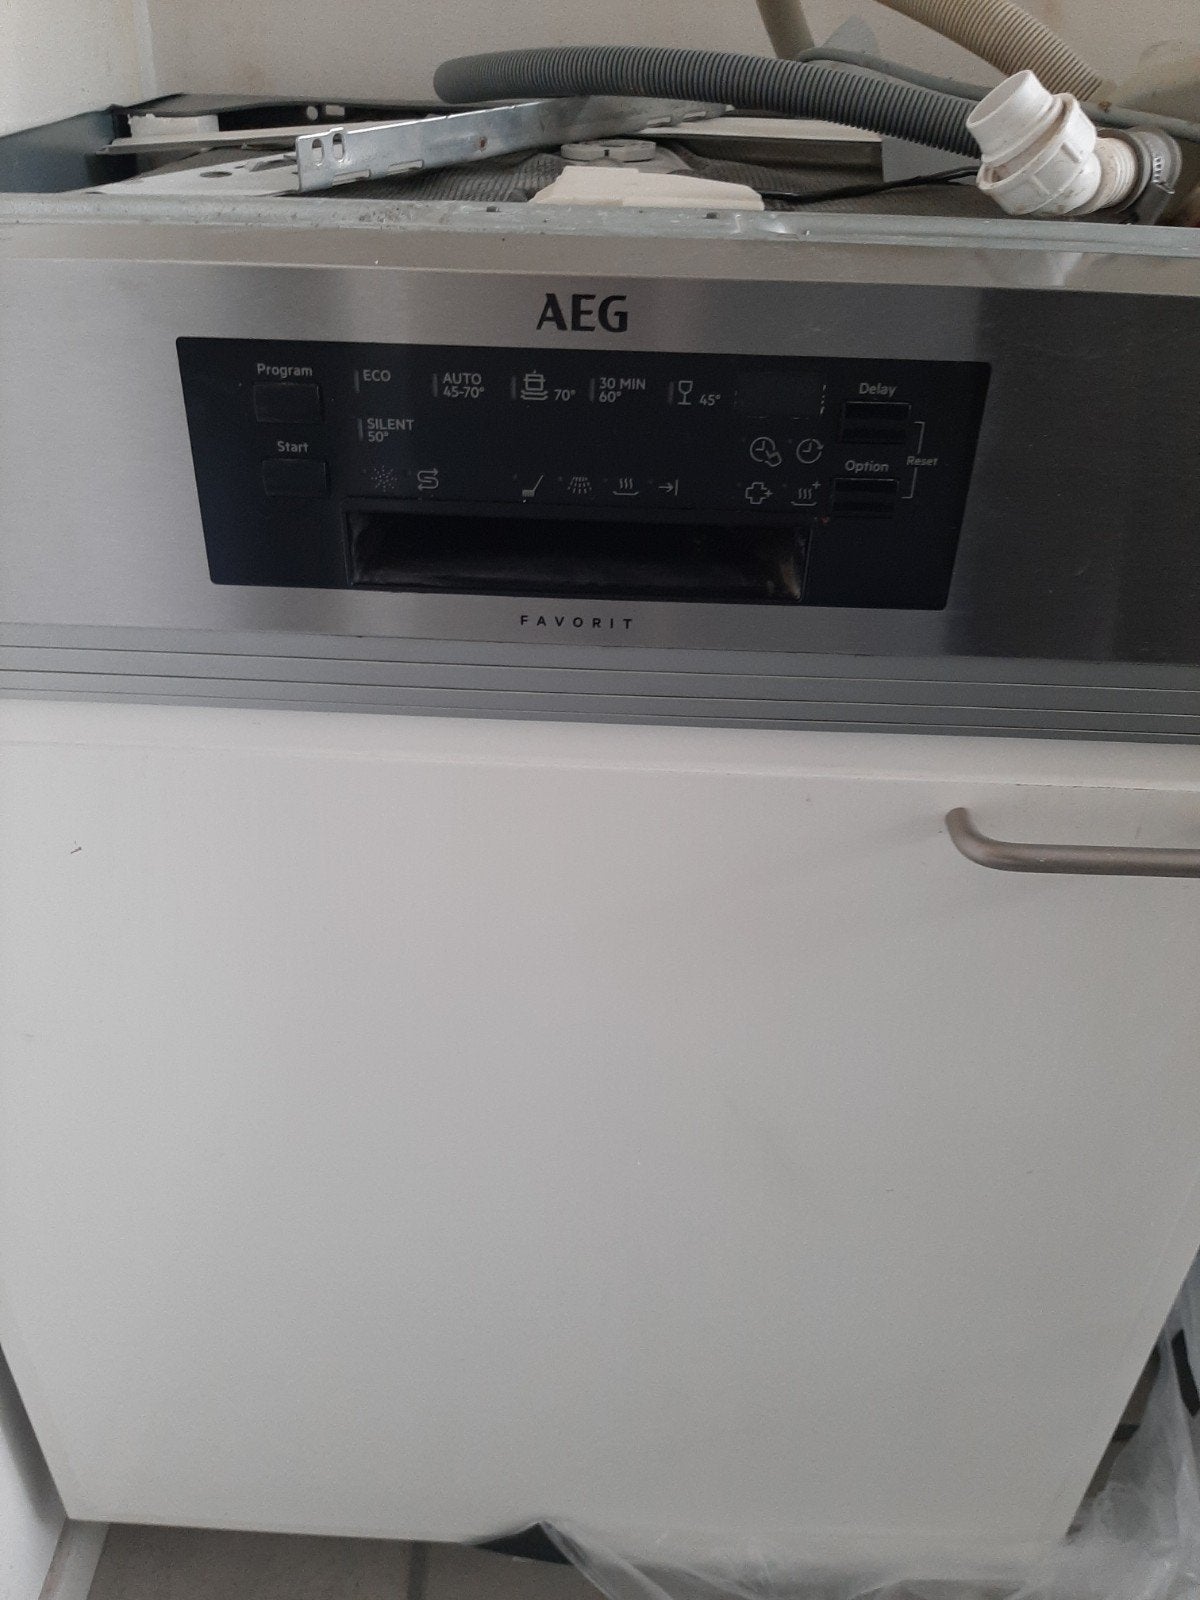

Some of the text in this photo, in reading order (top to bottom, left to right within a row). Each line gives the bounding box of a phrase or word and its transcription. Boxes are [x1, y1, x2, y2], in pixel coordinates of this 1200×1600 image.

[536, 293, 628, 332] AEG
[256, 363, 313, 378] Program
[363, 369, 391, 382] ECO
[443, 372, 482, 385] AUTO
[599, 377, 646, 390] 30 MIN
[555, 388, 576, 401] 70°
[859, 382, 897, 397] Delay
[599, 390, 622, 403] 60°
[700, 393, 721, 406] 45°
[367, 417, 415, 431] SILENT
[367, 430, 389, 442] 50°
[277, 440, 309, 454] Start
[845, 459, 889, 474] Option
[906, 454, 939, 467] Reset
[520, 615, 632, 629] FAVORIT
